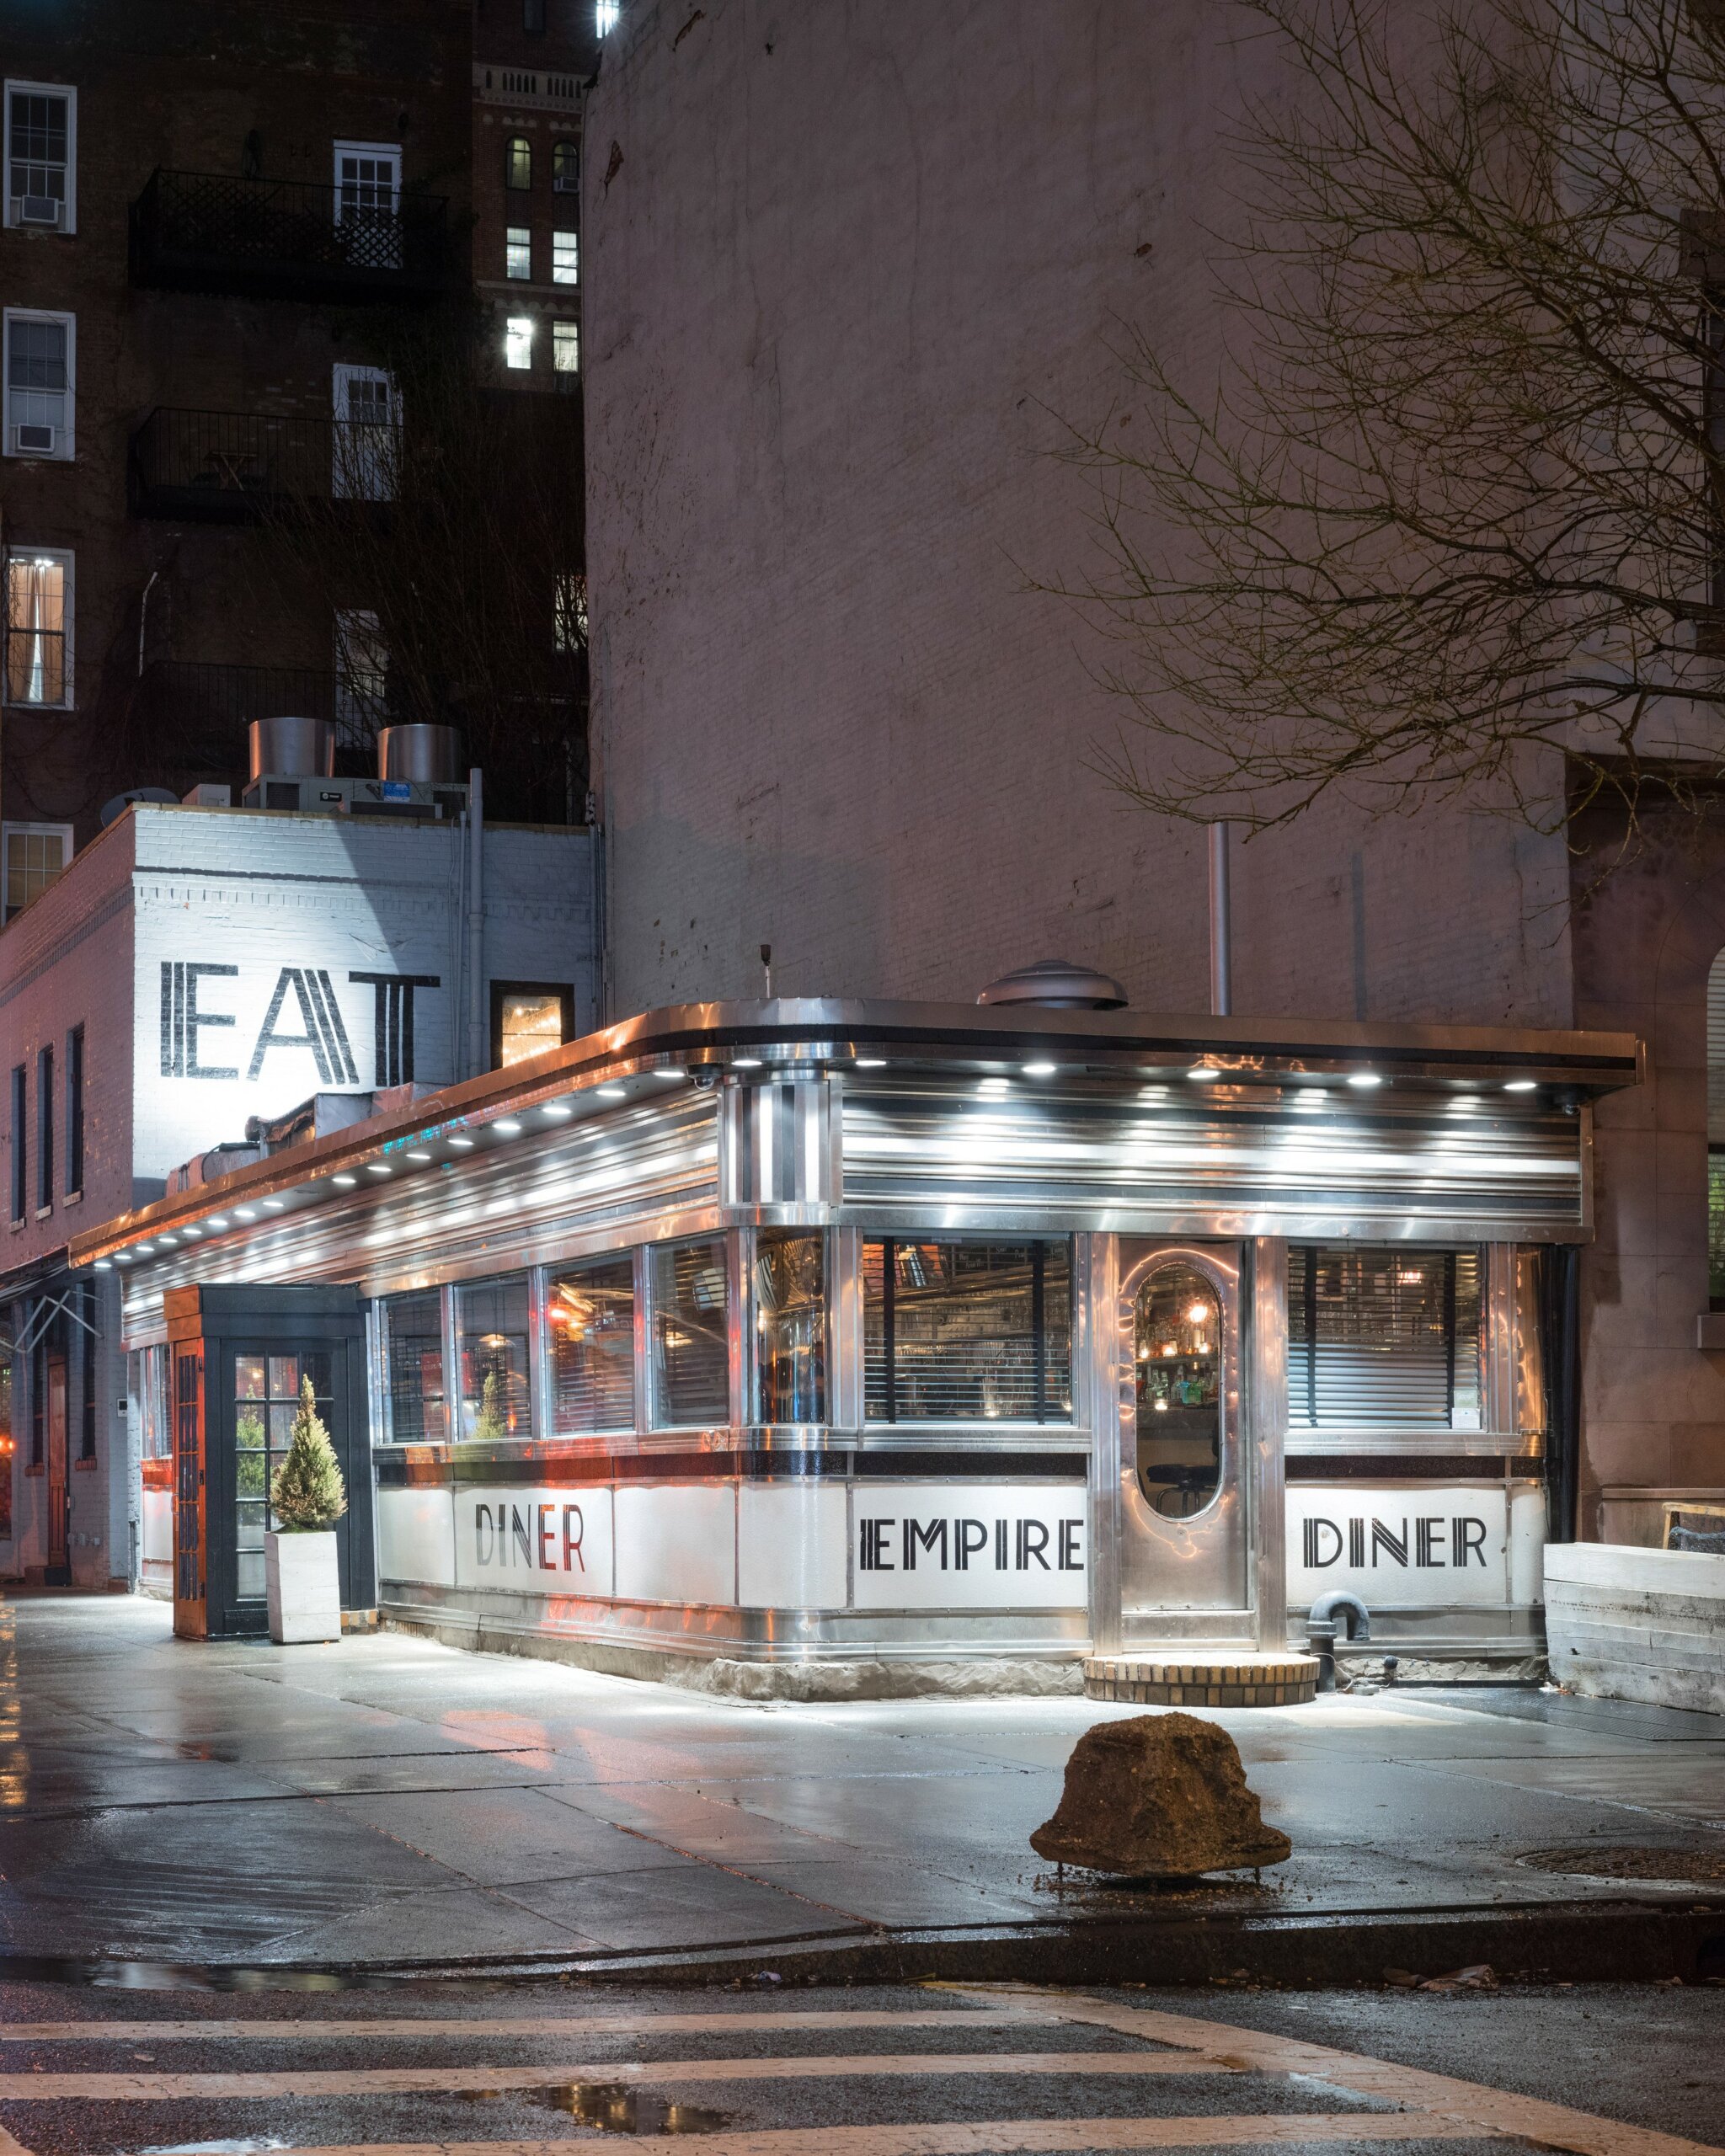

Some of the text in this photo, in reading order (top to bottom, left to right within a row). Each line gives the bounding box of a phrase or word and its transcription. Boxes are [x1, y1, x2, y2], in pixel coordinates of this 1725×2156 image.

[160, 961, 441, 1087] EAT
[476, 1503, 585, 1572] DINER
[860, 1517, 1487, 1571] EMPIRE DINER
